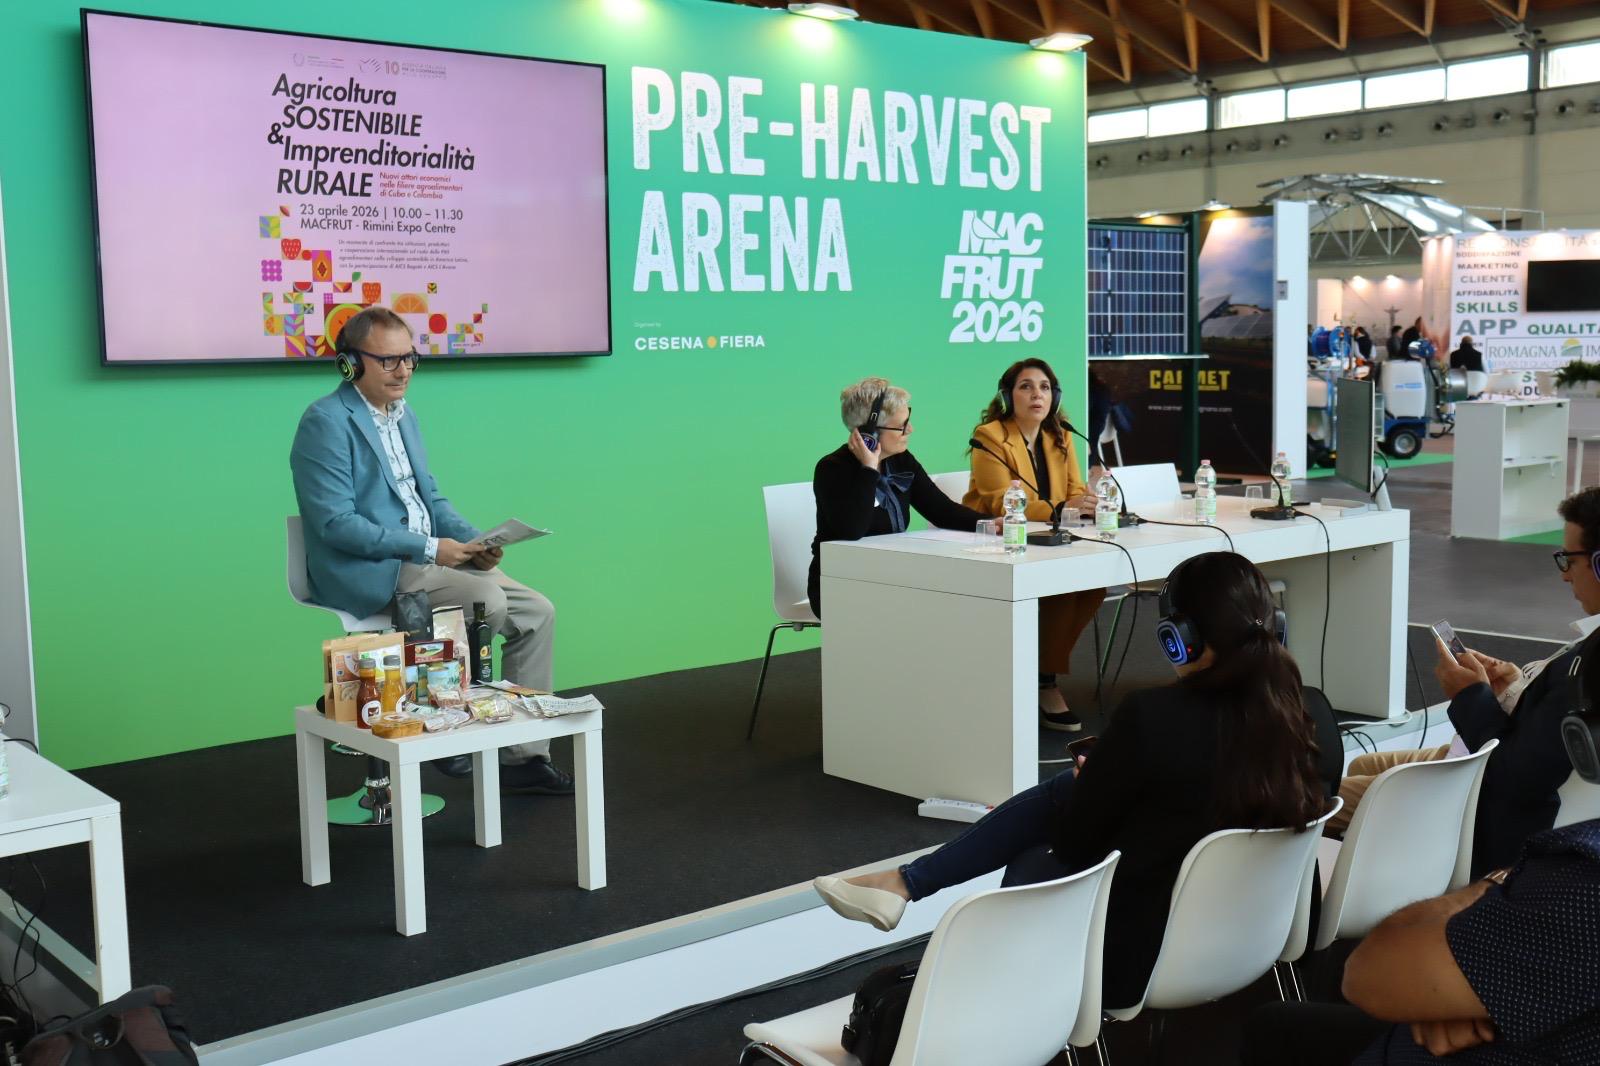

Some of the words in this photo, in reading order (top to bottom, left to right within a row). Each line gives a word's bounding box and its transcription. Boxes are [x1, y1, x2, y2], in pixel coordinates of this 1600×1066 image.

[271, 73, 397, 105] Agricoltura
[281, 104, 423, 137] SOSTENIBILE
[631, 66, 1052, 192] PRE-HARVEST
[267, 122, 284, 145] &
[283, 136, 475, 171] Imprenditorialità
[276, 168, 373, 197] RURALE
[380, 172, 399, 180] Nuovi
[388, 190, 406, 198] Cuba
[413, 190, 443, 199] Colombia
[300, 203, 314, 215] 23
[318, 204, 348, 219] aprile
[352, 206, 379, 218] 2026
[393, 207, 422, 219] 10.00
[435, 209, 463, 221] 11.30
[300, 217, 353, 231] MACFRUT
[363, 219, 394, 232] Rimini
[397, 221, 422, 235] Expo
[425, 221, 456, 234] Centre
[958, 210, 1044, 255] MAC
[633, 191, 852, 292] ARENA
[940, 254, 1044, 300] FRUT
[1460, 274, 1515, 284] CLIENTE
[1456, 301, 1518, 314] SKILLS
[948, 301, 1044, 343] 2026
[1456, 319, 1517, 336] APP
[634, 336, 704, 351] CESENA
[720, 335, 766, 349] FIERA
[1489, 345, 1558, 358] ROMAGNA
